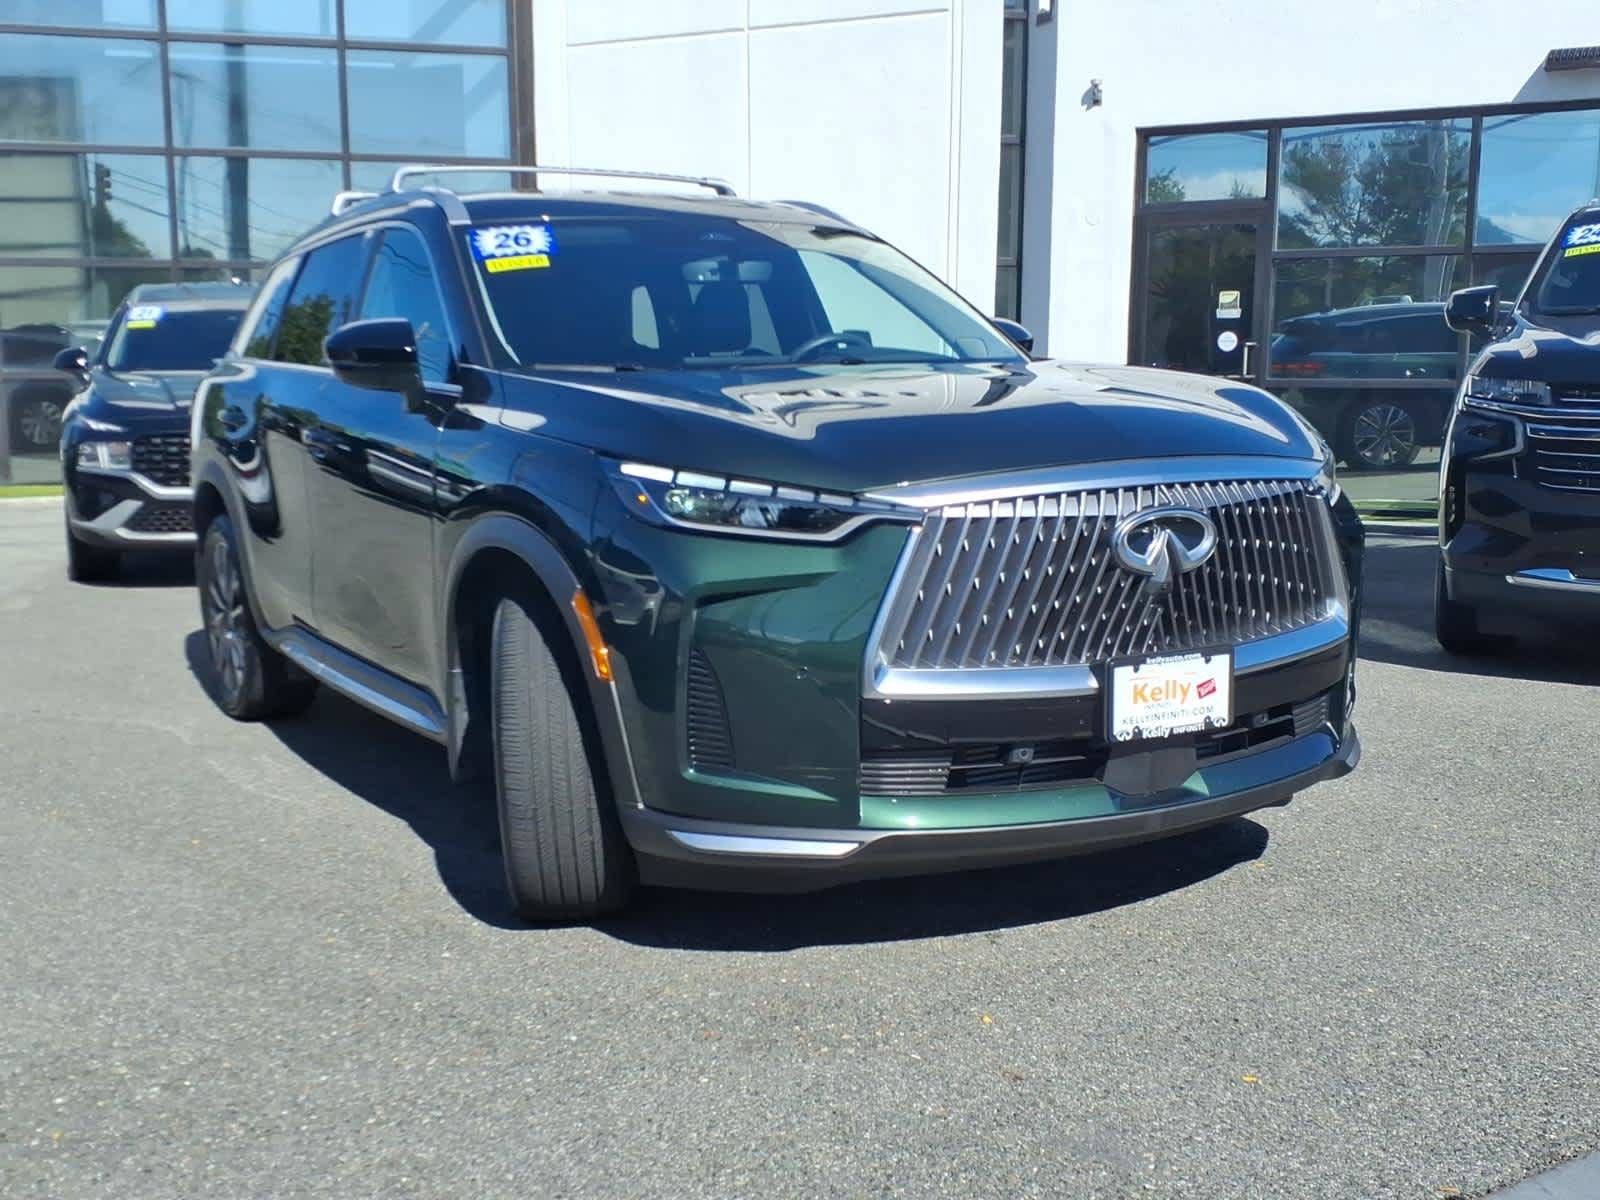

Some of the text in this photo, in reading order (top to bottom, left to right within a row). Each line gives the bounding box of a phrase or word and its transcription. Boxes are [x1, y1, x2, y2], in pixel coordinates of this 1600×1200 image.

[494, 231, 531, 249] 26
[1132, 680, 1191, 705] Kelly
[1142, 725, 1171, 739] Kelly
